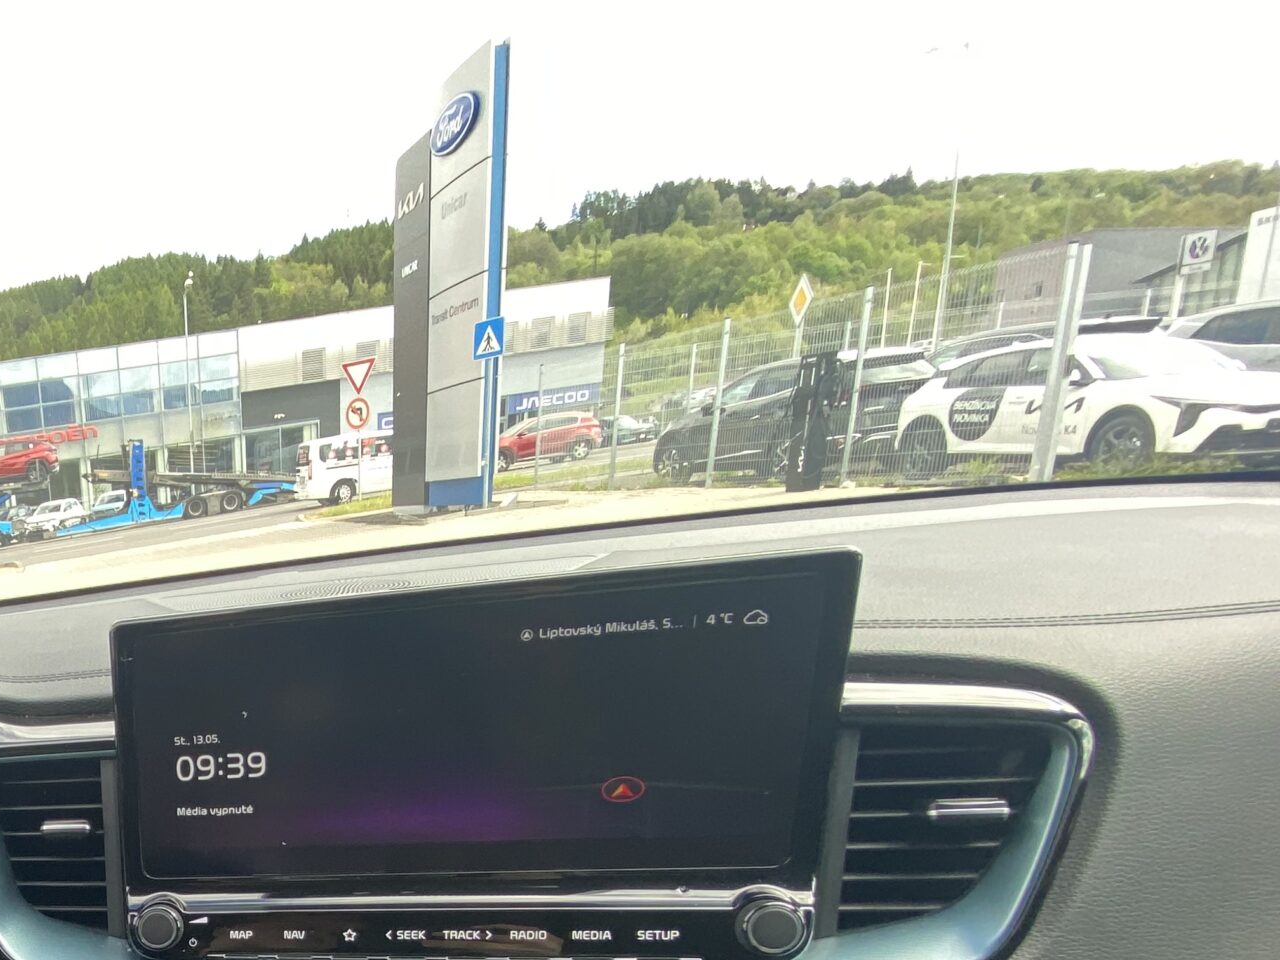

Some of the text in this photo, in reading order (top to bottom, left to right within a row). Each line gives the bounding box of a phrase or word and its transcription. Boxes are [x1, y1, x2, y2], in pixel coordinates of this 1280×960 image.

[436, 103, 465, 149] Ford
[440, 191, 468, 221] Unicar
[431, 296, 479, 327] Transit Centrum
[516, 390, 589, 410] JAECOO
[539, 623, 601, 639] Liptovský
[193, 734, 221, 745] 13.05.
[176, 752, 266, 781] 09:39
[176, 804, 254, 816] Média vypnuté
[229, 930, 253, 940] MAP
[283, 930, 305, 940] NAV
[396, 930, 426, 940] SEEK
[443, 930, 481, 940] TRACK
[509, 930, 547, 940] RADIO
[571, 930, 612, 940] MEDIA
[637, 930, 680, 940] SETUP
